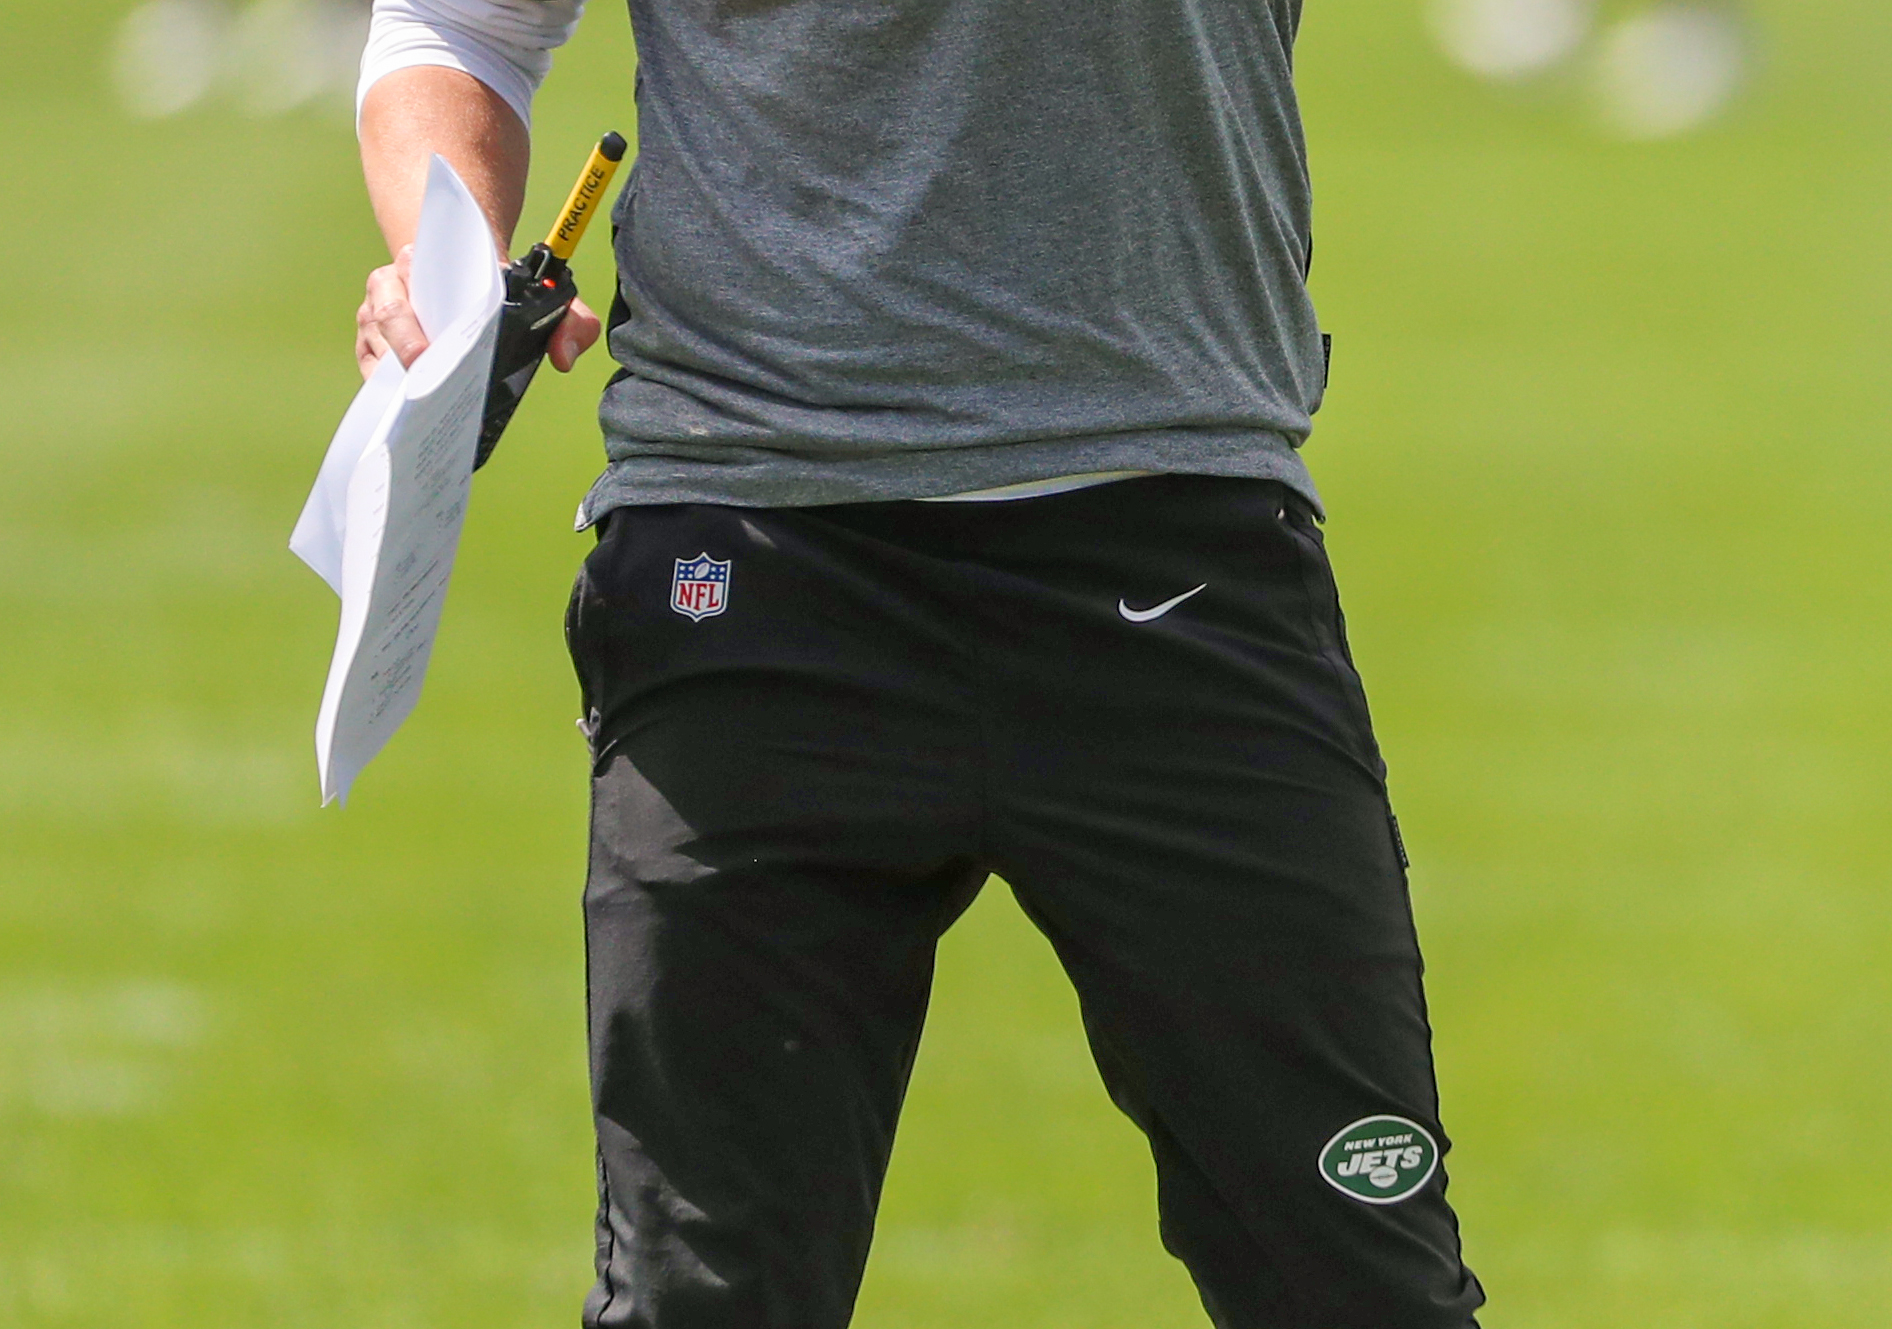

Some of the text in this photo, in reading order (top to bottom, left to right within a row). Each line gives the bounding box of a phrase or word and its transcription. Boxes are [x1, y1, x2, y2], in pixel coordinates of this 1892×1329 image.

[557, 165, 606, 242] PRACTICE
[677, 582, 719, 611] NFL
[1344, 1133, 1413, 1151] NEW YORK
[1337, 1145, 1423, 1177] JETS
